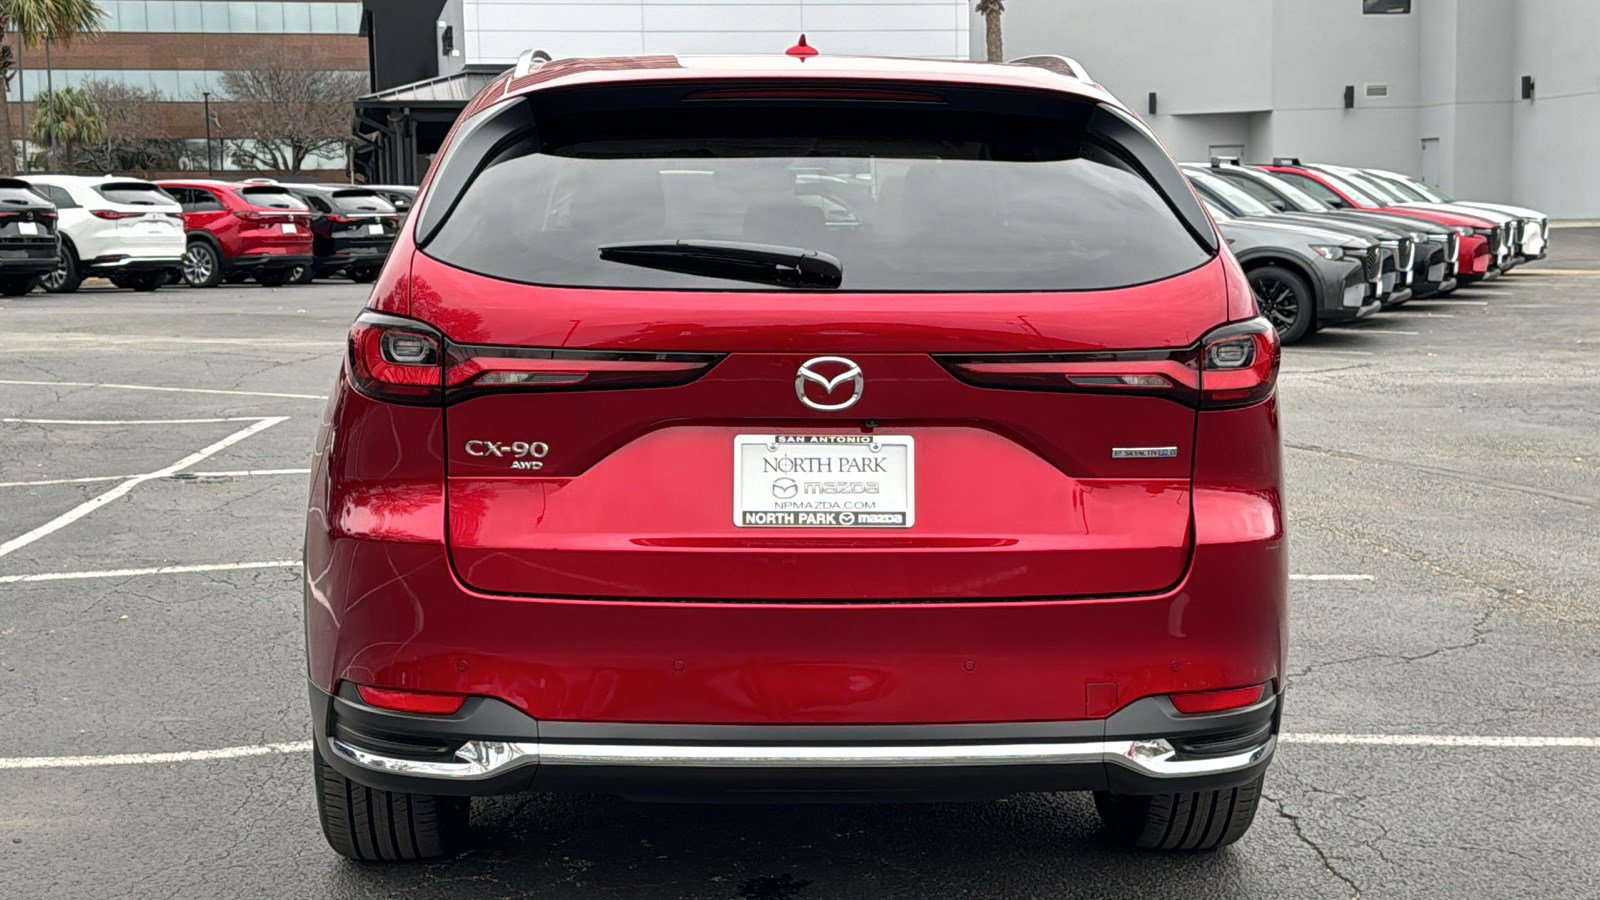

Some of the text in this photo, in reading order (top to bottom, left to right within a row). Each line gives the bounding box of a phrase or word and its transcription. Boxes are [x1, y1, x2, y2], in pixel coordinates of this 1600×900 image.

[465, 440, 549, 458] CX-90
[510, 460, 544, 470] AWD
[763, 456, 888, 473] NORTH PARK
[804, 481, 880, 494] mazda
[774, 501, 876, 510] NPMAZDA.COM
[745, 512, 903, 525] NORTH PARK mazda
